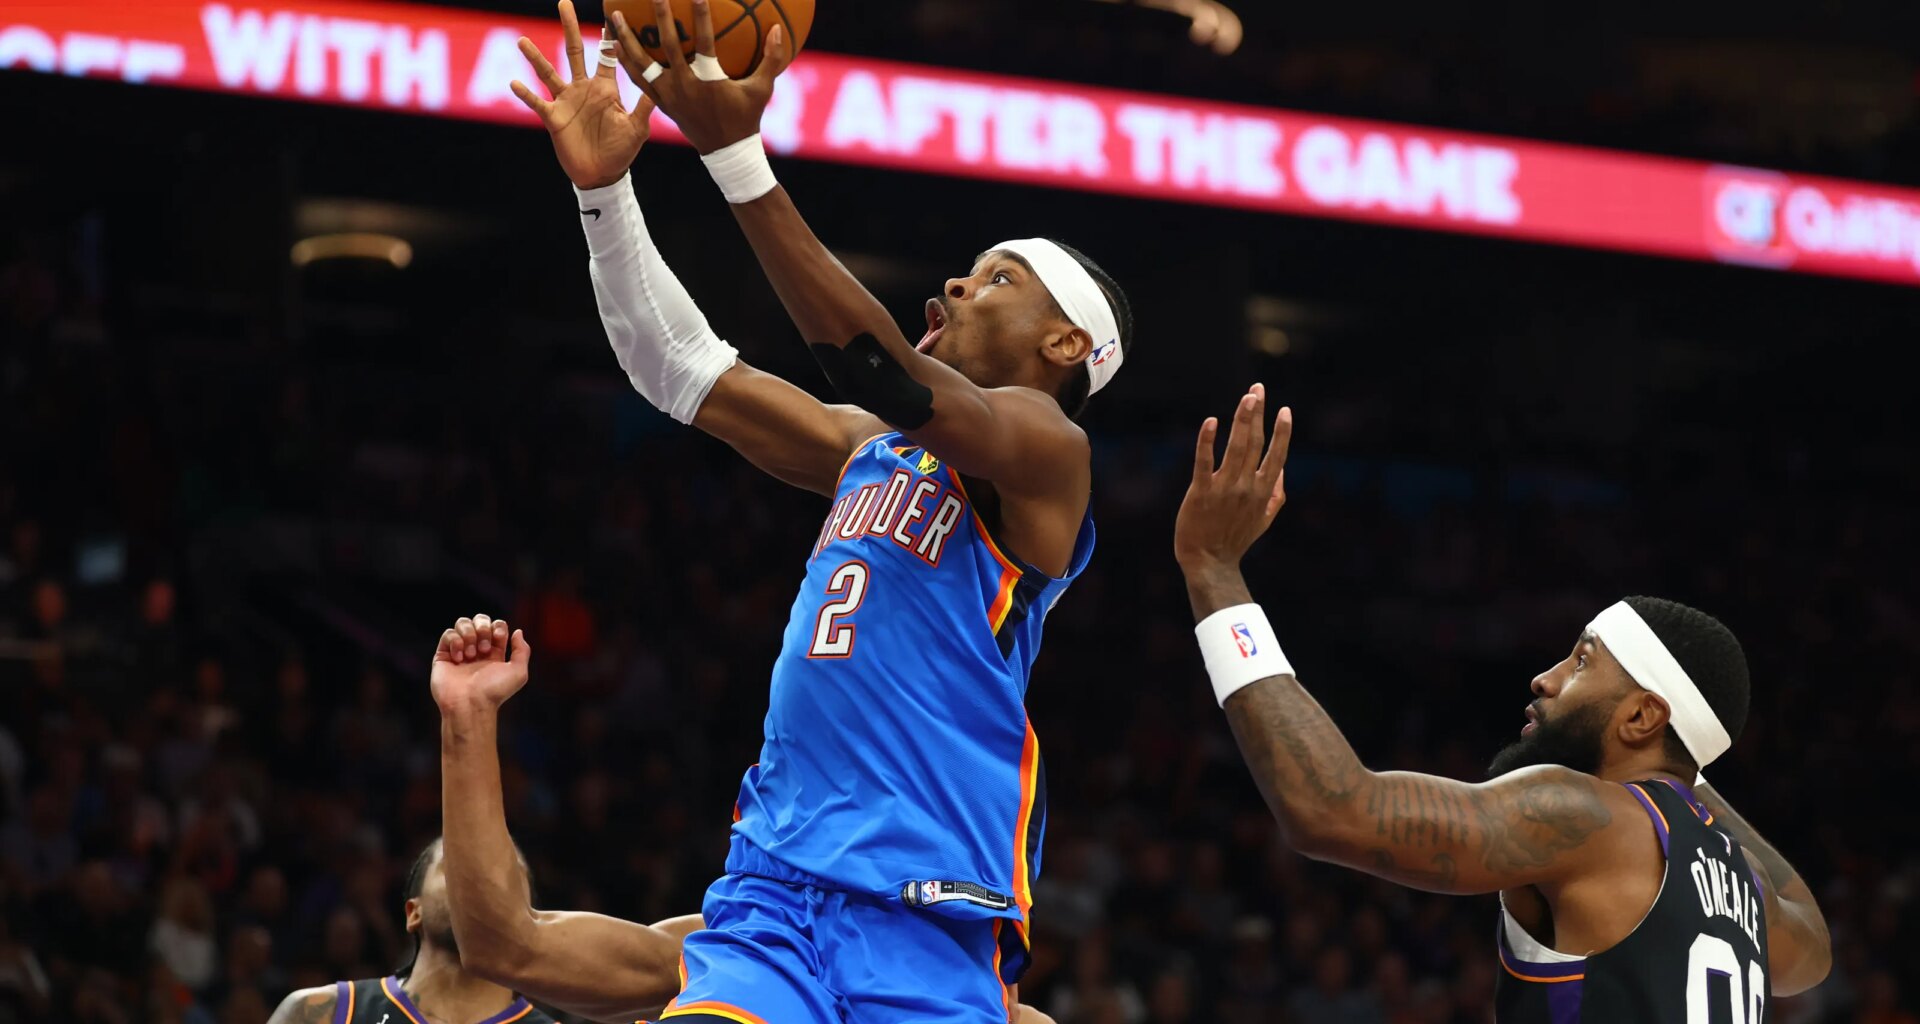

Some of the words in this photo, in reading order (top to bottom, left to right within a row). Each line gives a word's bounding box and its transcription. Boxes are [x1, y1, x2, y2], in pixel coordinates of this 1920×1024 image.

[200, 3, 448, 111] WITH
[824, 69, 1110, 179] AFTER
[1115, 103, 1285, 197] THE
[1291, 124, 1524, 227] GAME
[806, 559, 870, 659] 2
